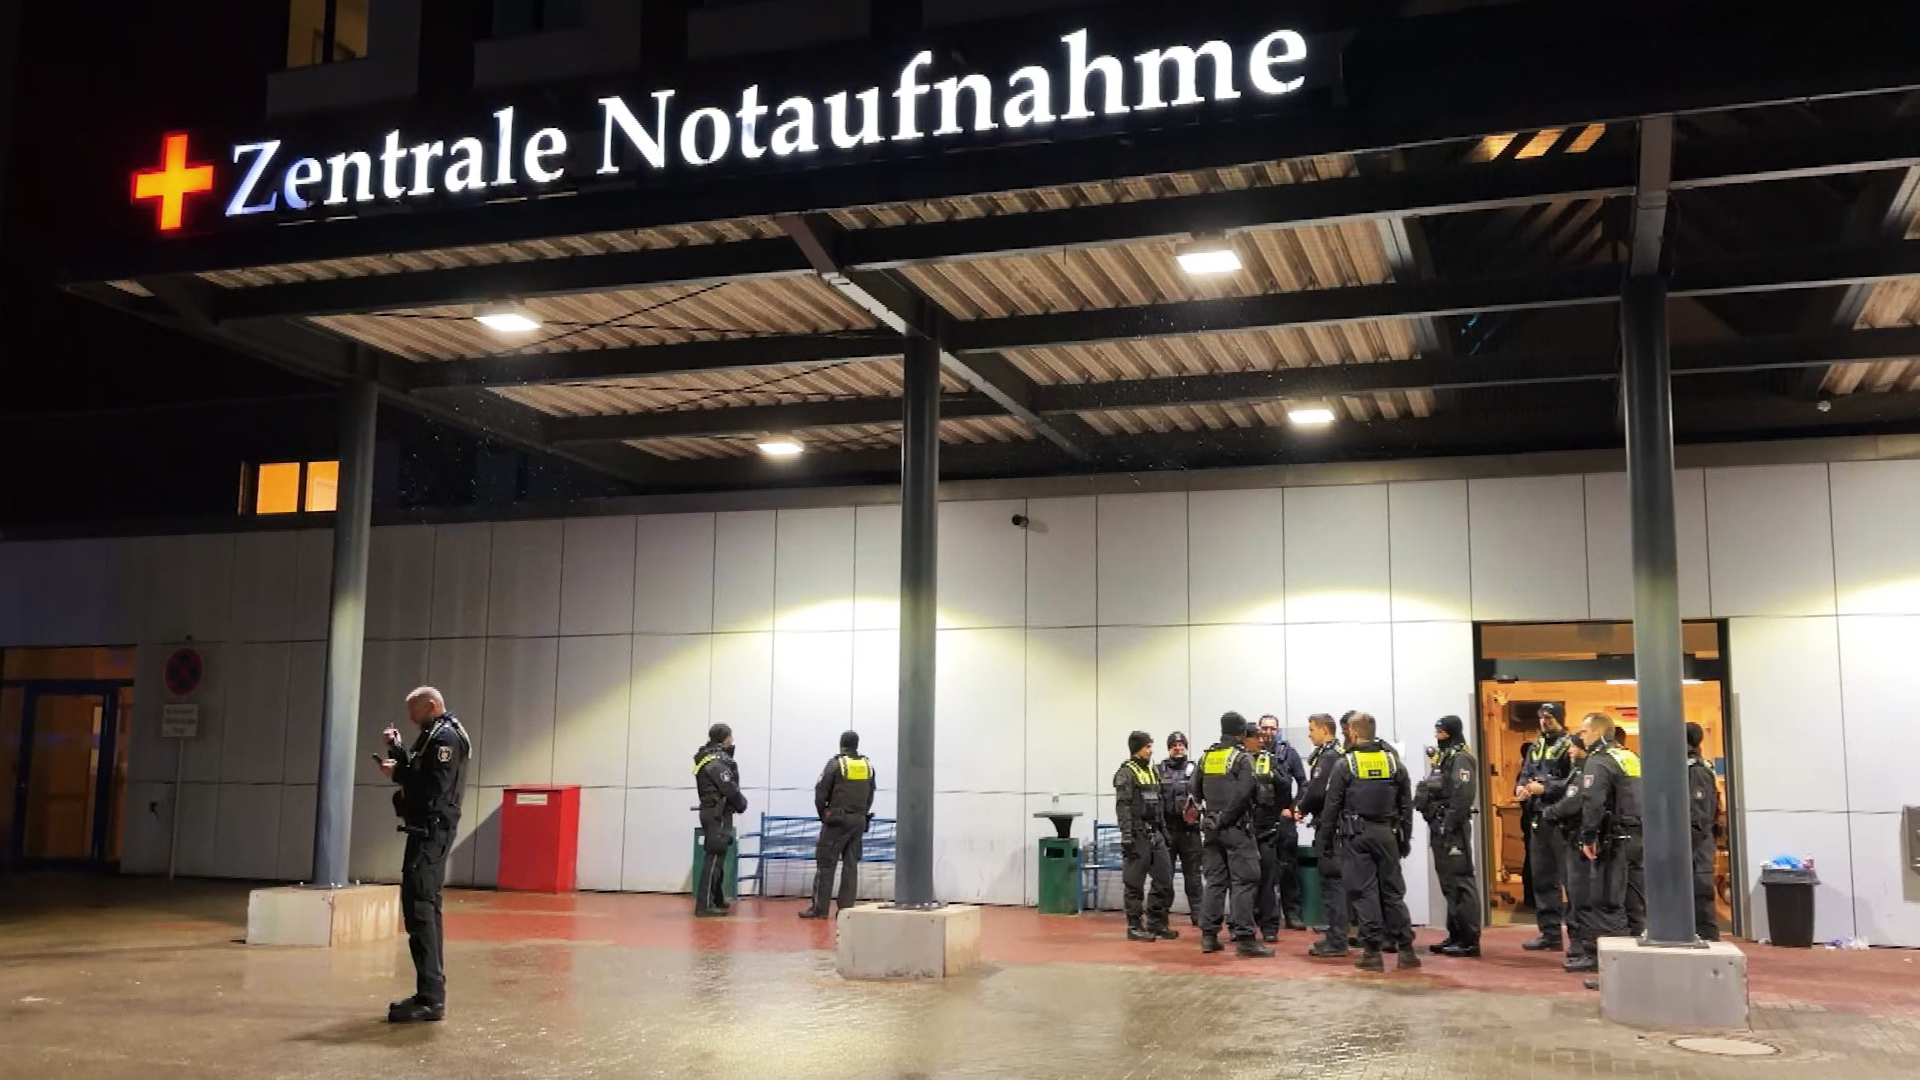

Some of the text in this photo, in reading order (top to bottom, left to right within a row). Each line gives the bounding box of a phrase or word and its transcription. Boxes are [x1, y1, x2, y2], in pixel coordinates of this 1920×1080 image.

[225, 28, 1308, 217] Zentrale Notaufnahme
[1360, 760, 1387, 769] POLIZEI
